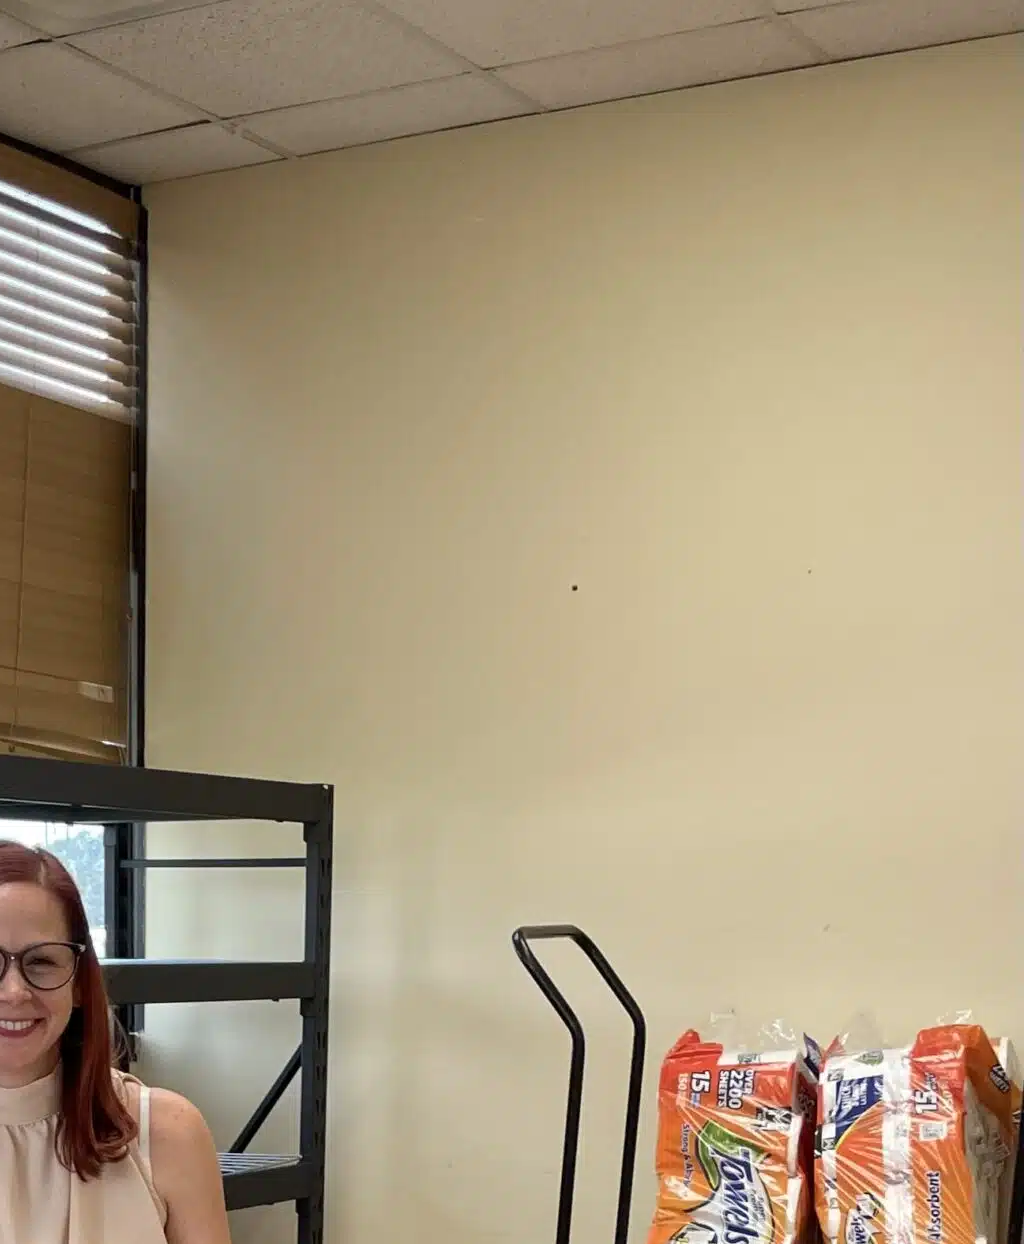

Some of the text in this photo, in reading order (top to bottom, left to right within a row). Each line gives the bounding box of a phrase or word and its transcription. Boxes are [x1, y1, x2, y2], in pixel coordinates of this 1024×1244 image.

[691, 1071, 710, 1092] 15
[718, 1071, 729, 1108] SHEETS
[728, 1069, 743, 1109] 2200
[928, 1171, 943, 1244] Absorbent
